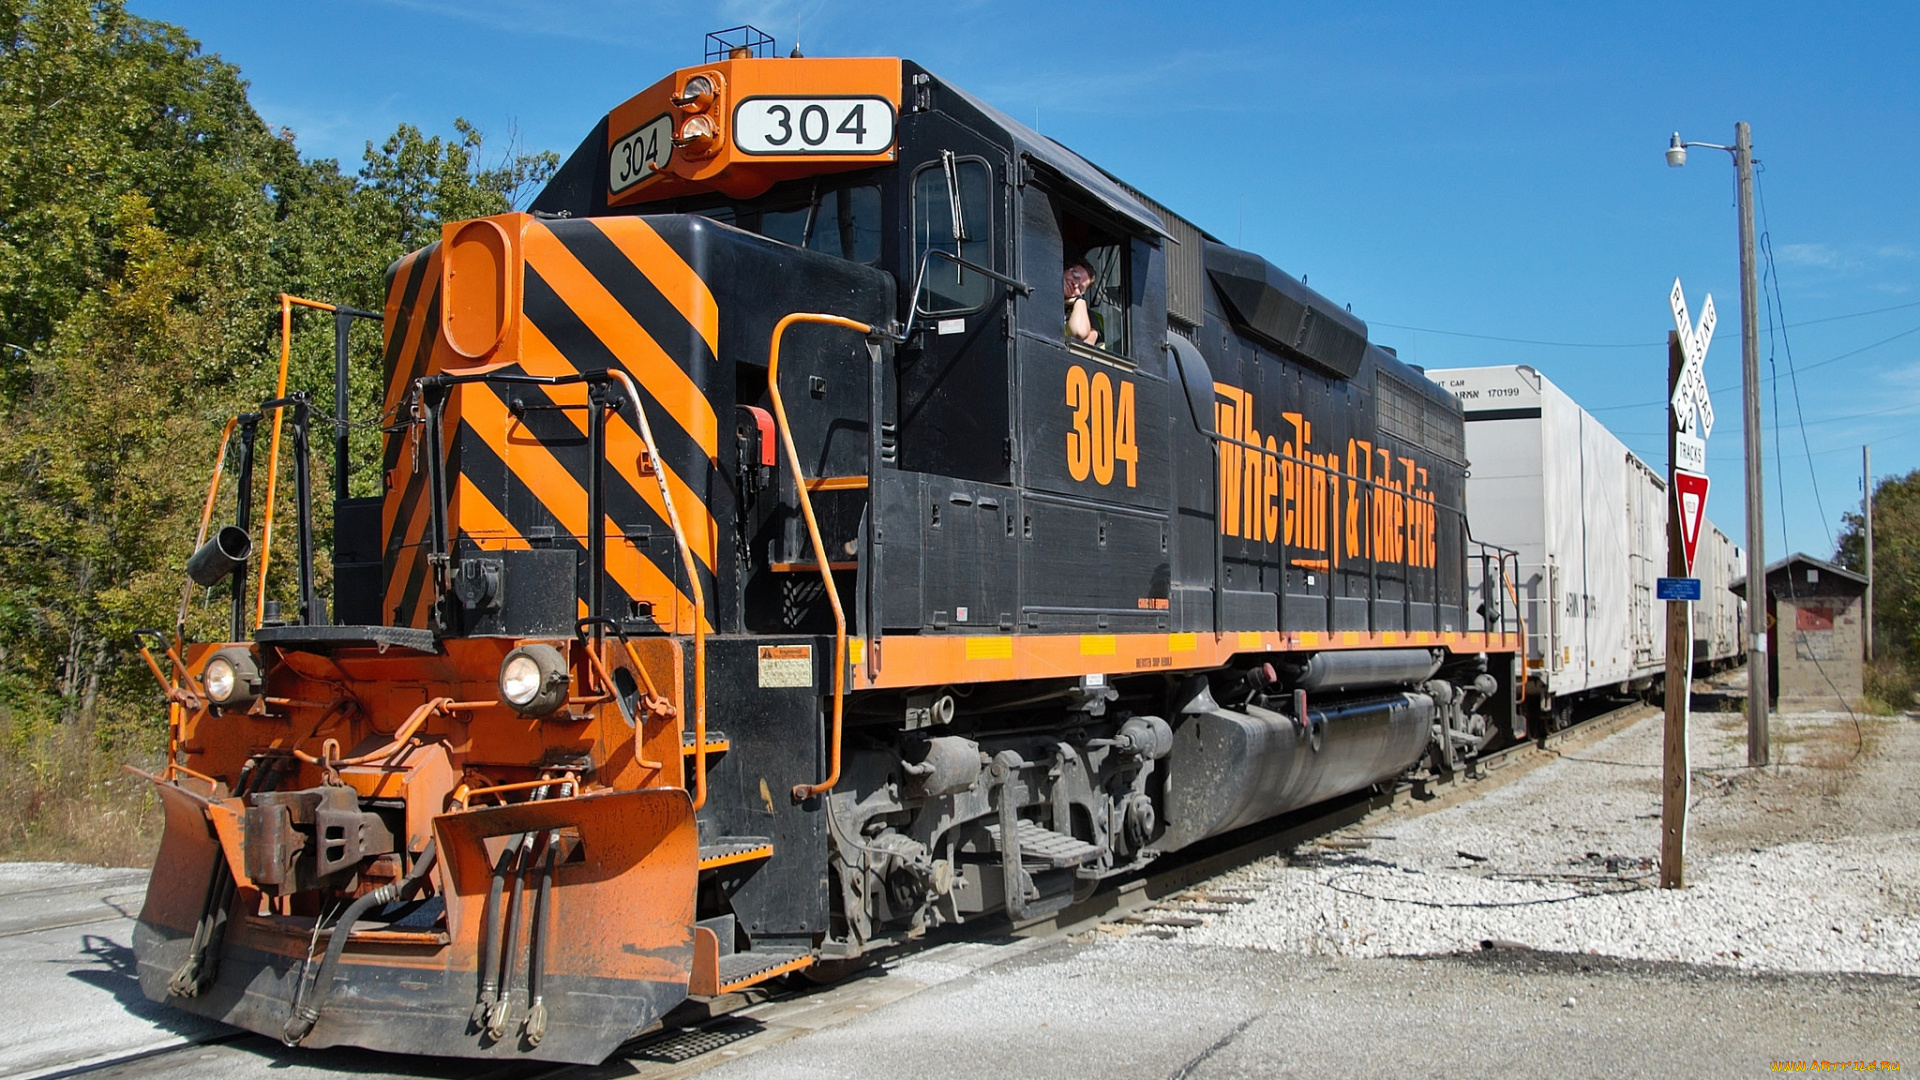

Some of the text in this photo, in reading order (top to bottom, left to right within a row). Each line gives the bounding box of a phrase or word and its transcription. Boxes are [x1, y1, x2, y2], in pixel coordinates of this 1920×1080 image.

[764, 104, 867, 146] 304
[620, 127, 658, 182] 304
[1677, 303, 1714, 418] CROSSING
[1450, 380, 1465, 388] CAR
[1487, 387, 1519, 398] 170199
[1066, 364, 1138, 487] 304
[1688, 406, 1694, 430] 2
[1679, 441, 1702, 463] TRACKS
[1213, 381, 1340, 573] Wheeling
[1346, 437, 1359, 560] &
[1397, 456, 1437, 570] Erie
